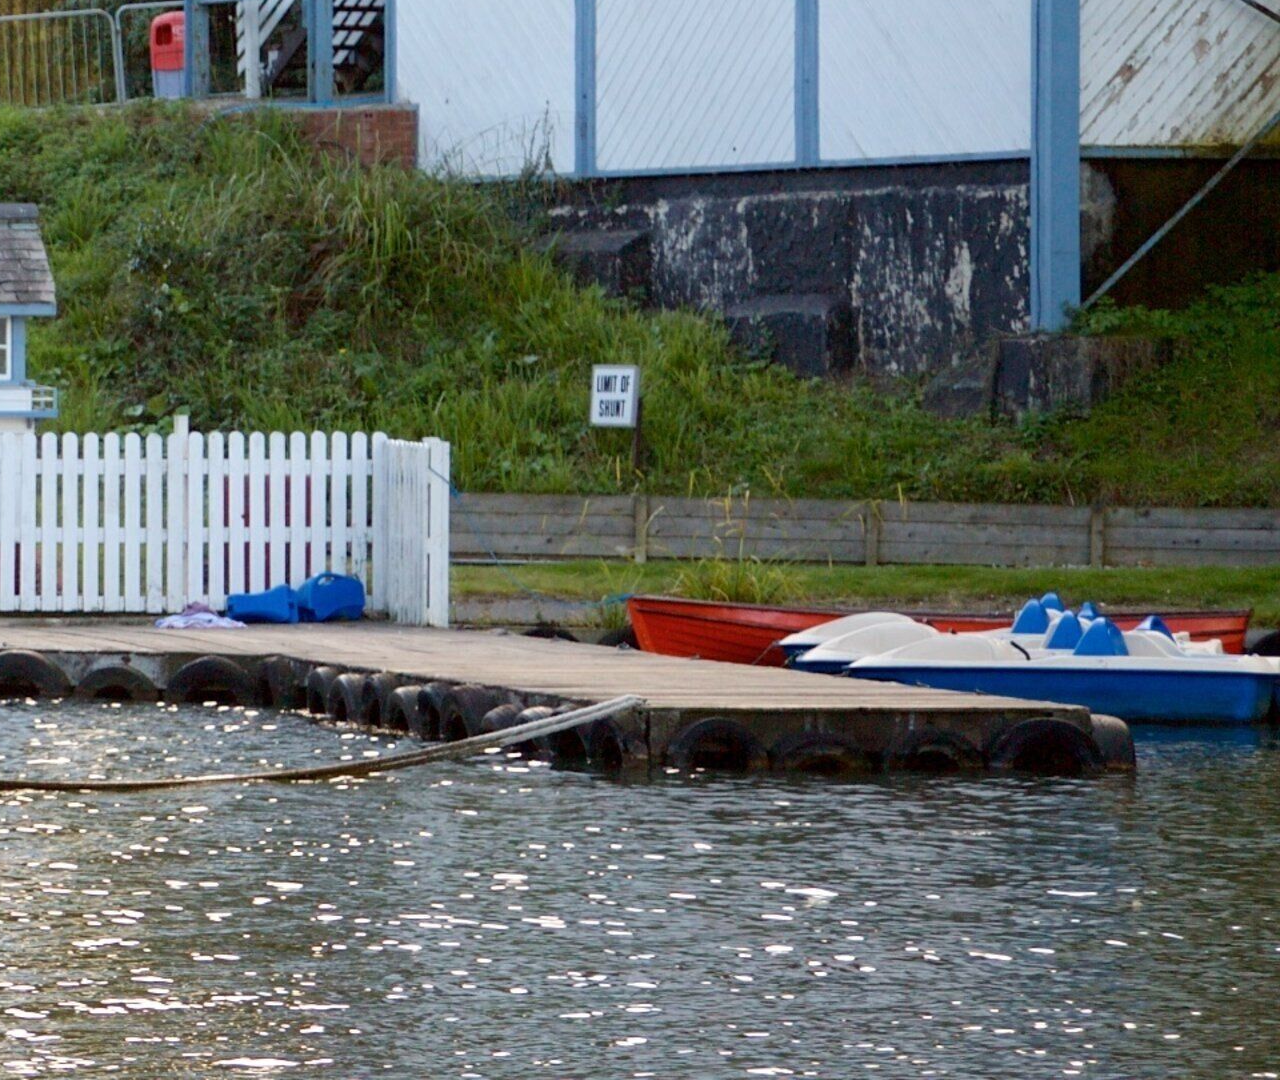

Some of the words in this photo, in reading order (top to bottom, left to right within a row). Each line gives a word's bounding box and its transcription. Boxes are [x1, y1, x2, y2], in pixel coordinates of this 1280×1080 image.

[596, 375, 617, 392] LIMIT
[620, 375, 630, 392] OF
[598, 399, 626, 418] SHUNT
